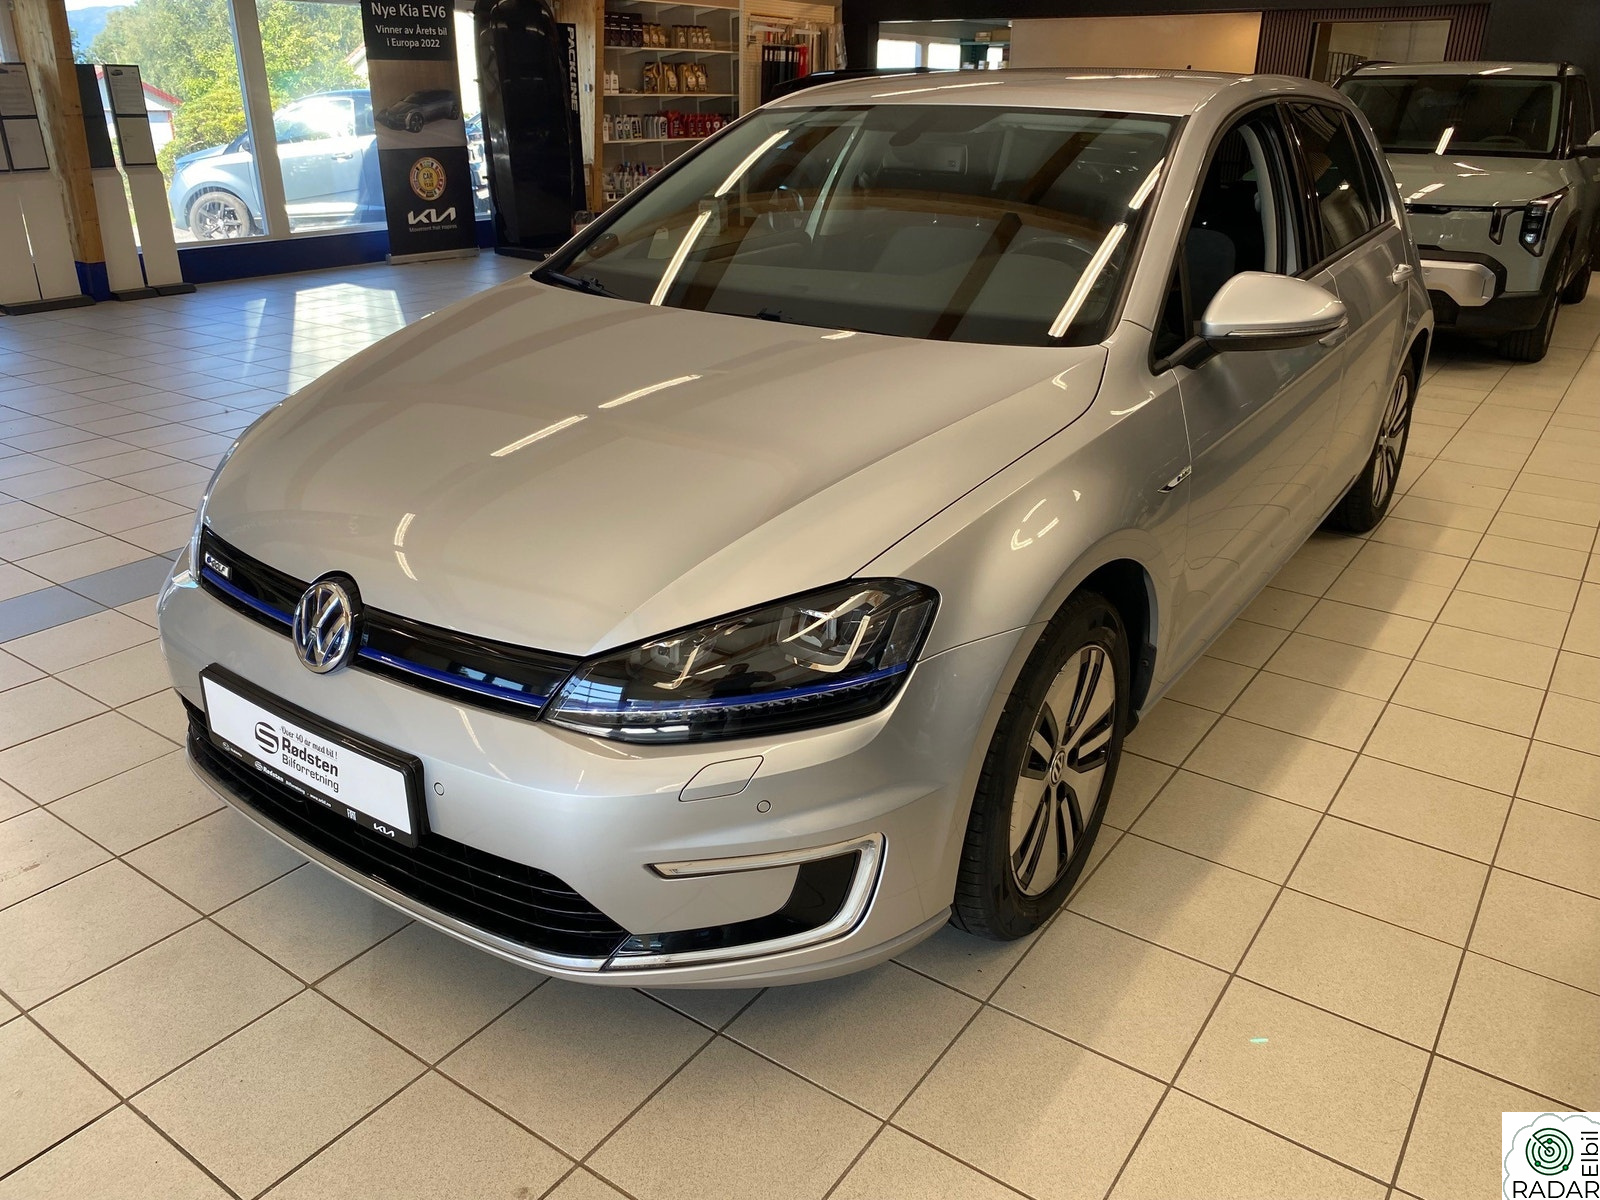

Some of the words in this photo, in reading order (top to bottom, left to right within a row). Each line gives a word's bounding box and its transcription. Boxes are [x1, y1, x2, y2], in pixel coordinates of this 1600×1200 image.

[371, 2, 397, 19] Nye
[399, 3, 419, 17] Kia
[422, 4, 447, 18] EV6
[375, 24, 402, 34] Vinner
[404, 27, 414, 35] av
[415, 24, 437, 35] Årets
[437, 27, 448, 36] bil
[386, 37, 390, 46] i
[391, 38, 420, 49] Europa
[421, 38, 441, 48] 2022
[567, 26, 579, 112] PACKLINE
[422, 172, 434, 180] CAR
[407, 207, 457, 225] KIA
[281, 736, 339, 777] Rødsten
[281, 753, 340, 793] Bilforretning
